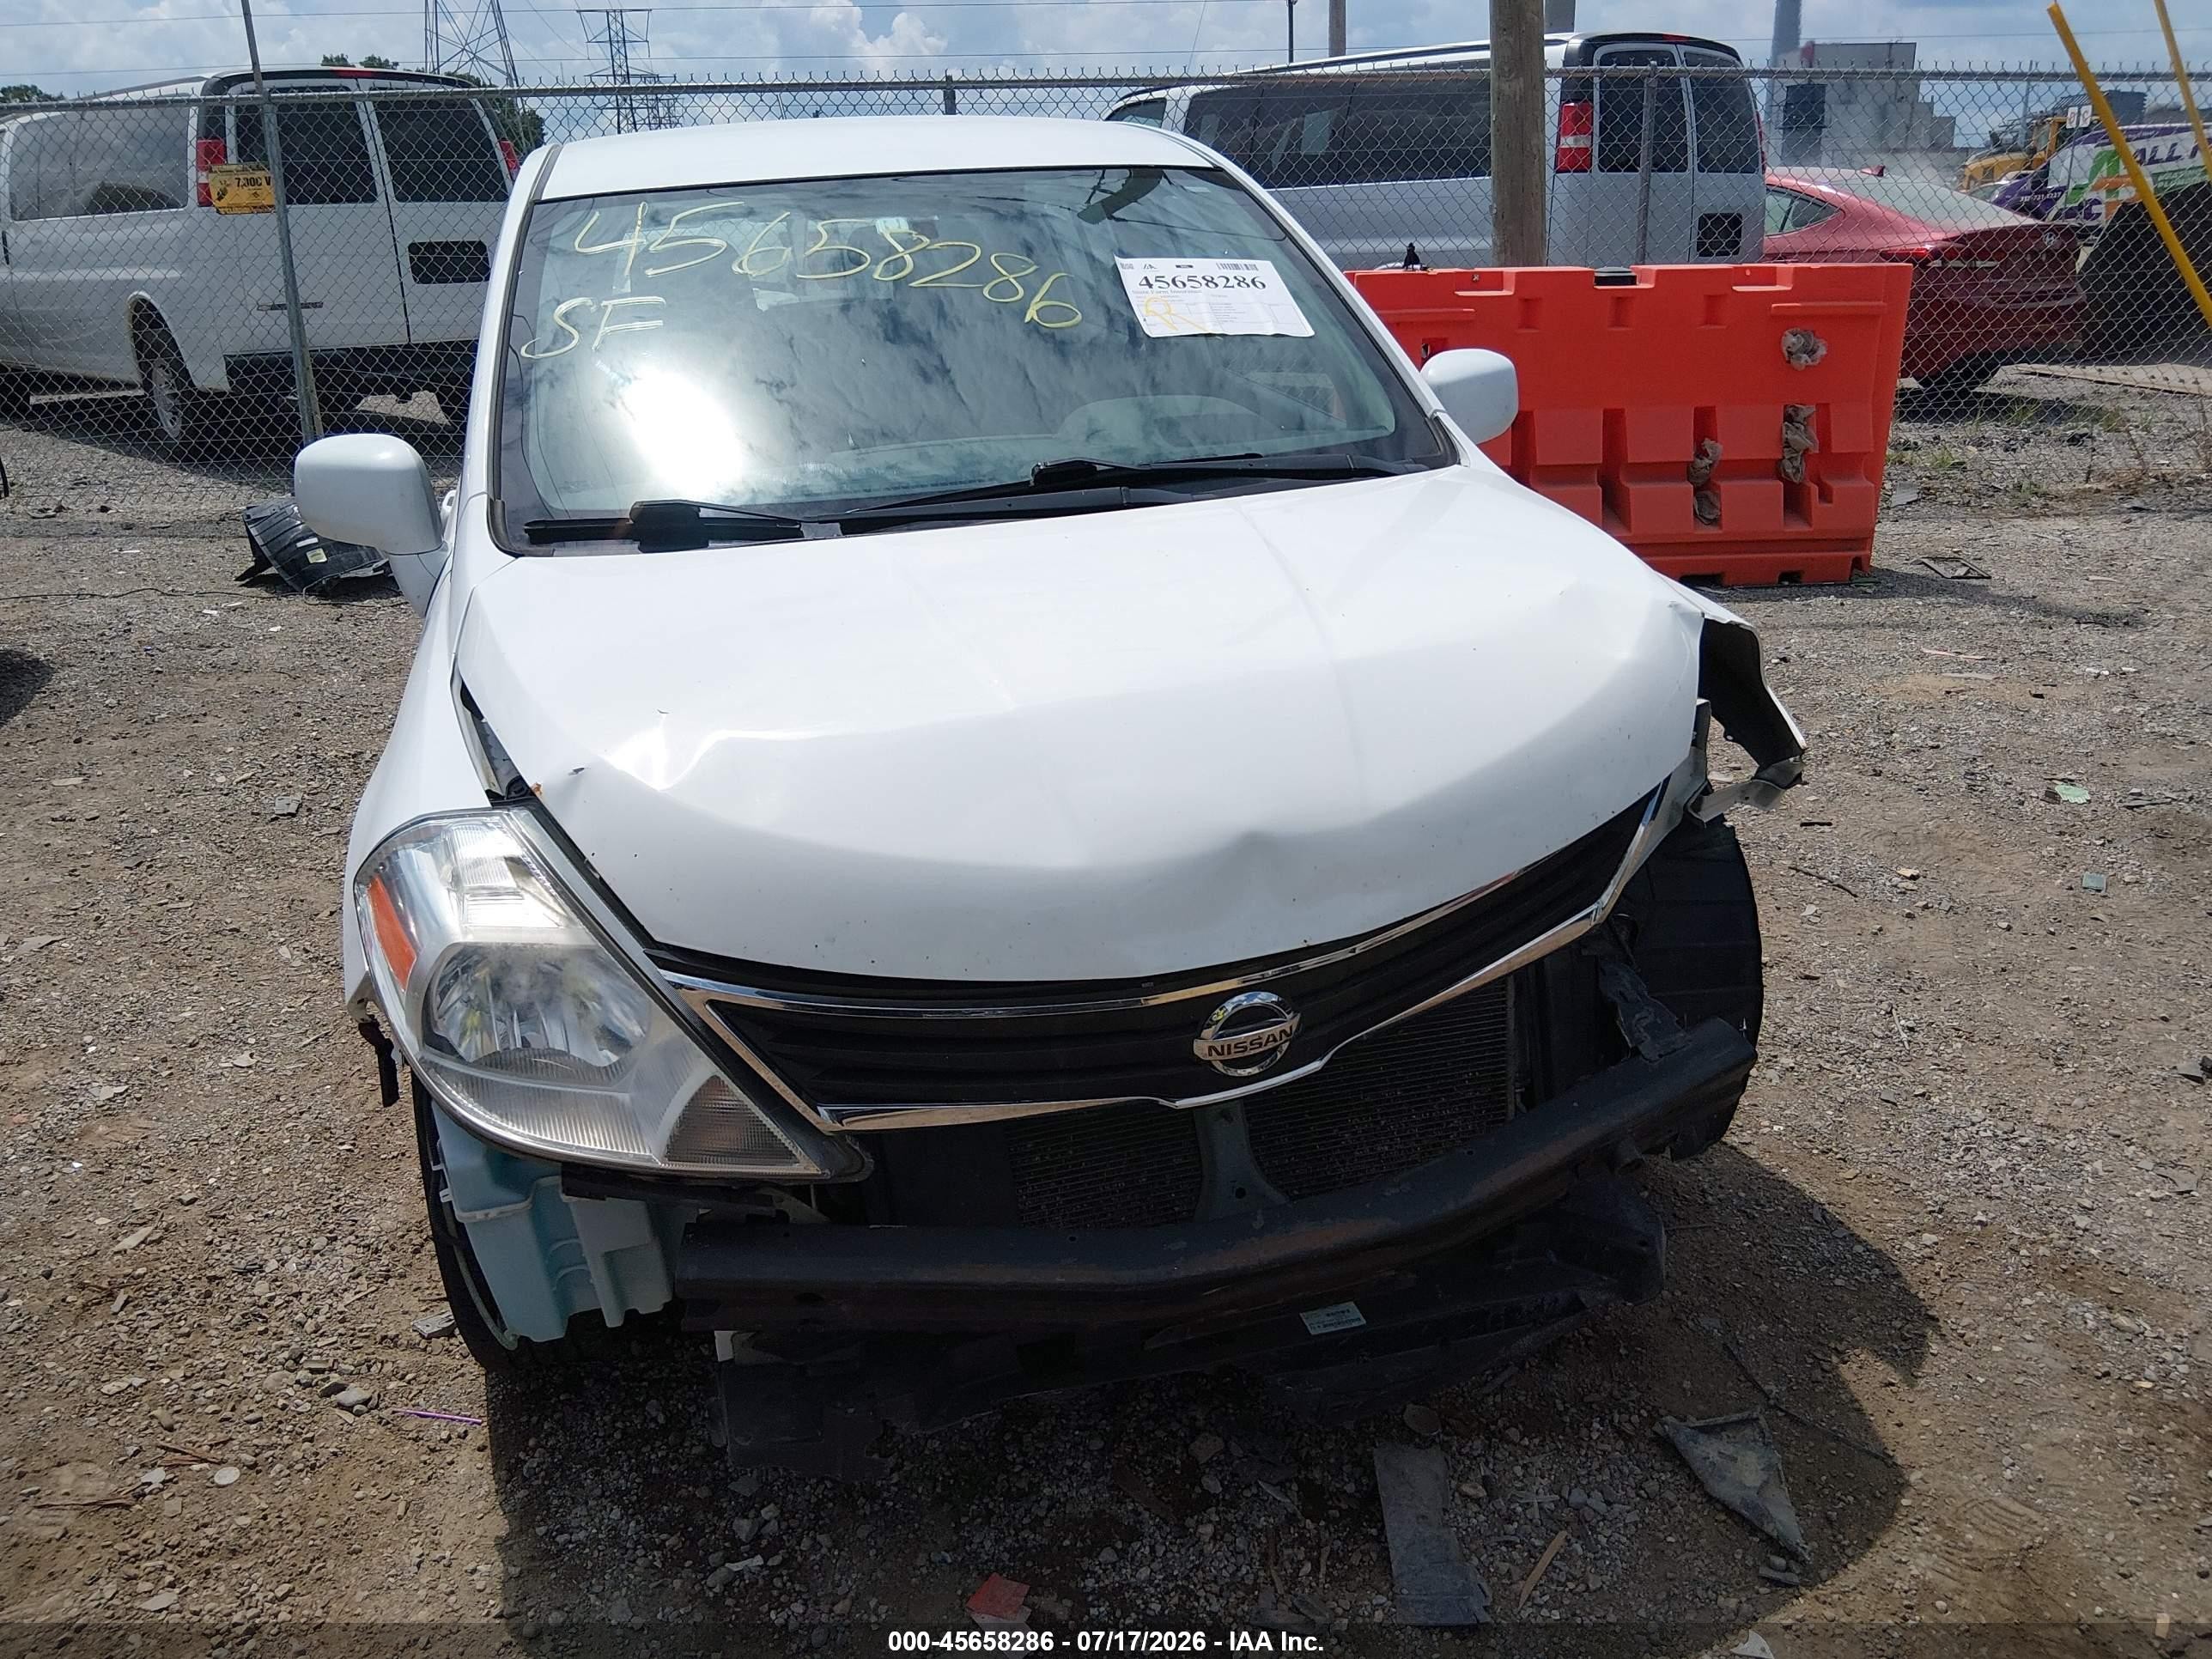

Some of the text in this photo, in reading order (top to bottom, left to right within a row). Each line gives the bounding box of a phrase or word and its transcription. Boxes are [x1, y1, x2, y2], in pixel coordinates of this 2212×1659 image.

[573, 201, 1083, 329] 45658286
[1139, 275, 1267, 290] 45658286
[520, 295, 666, 360] SF
[1207, 1025, 1293, 1057] NISSAN
